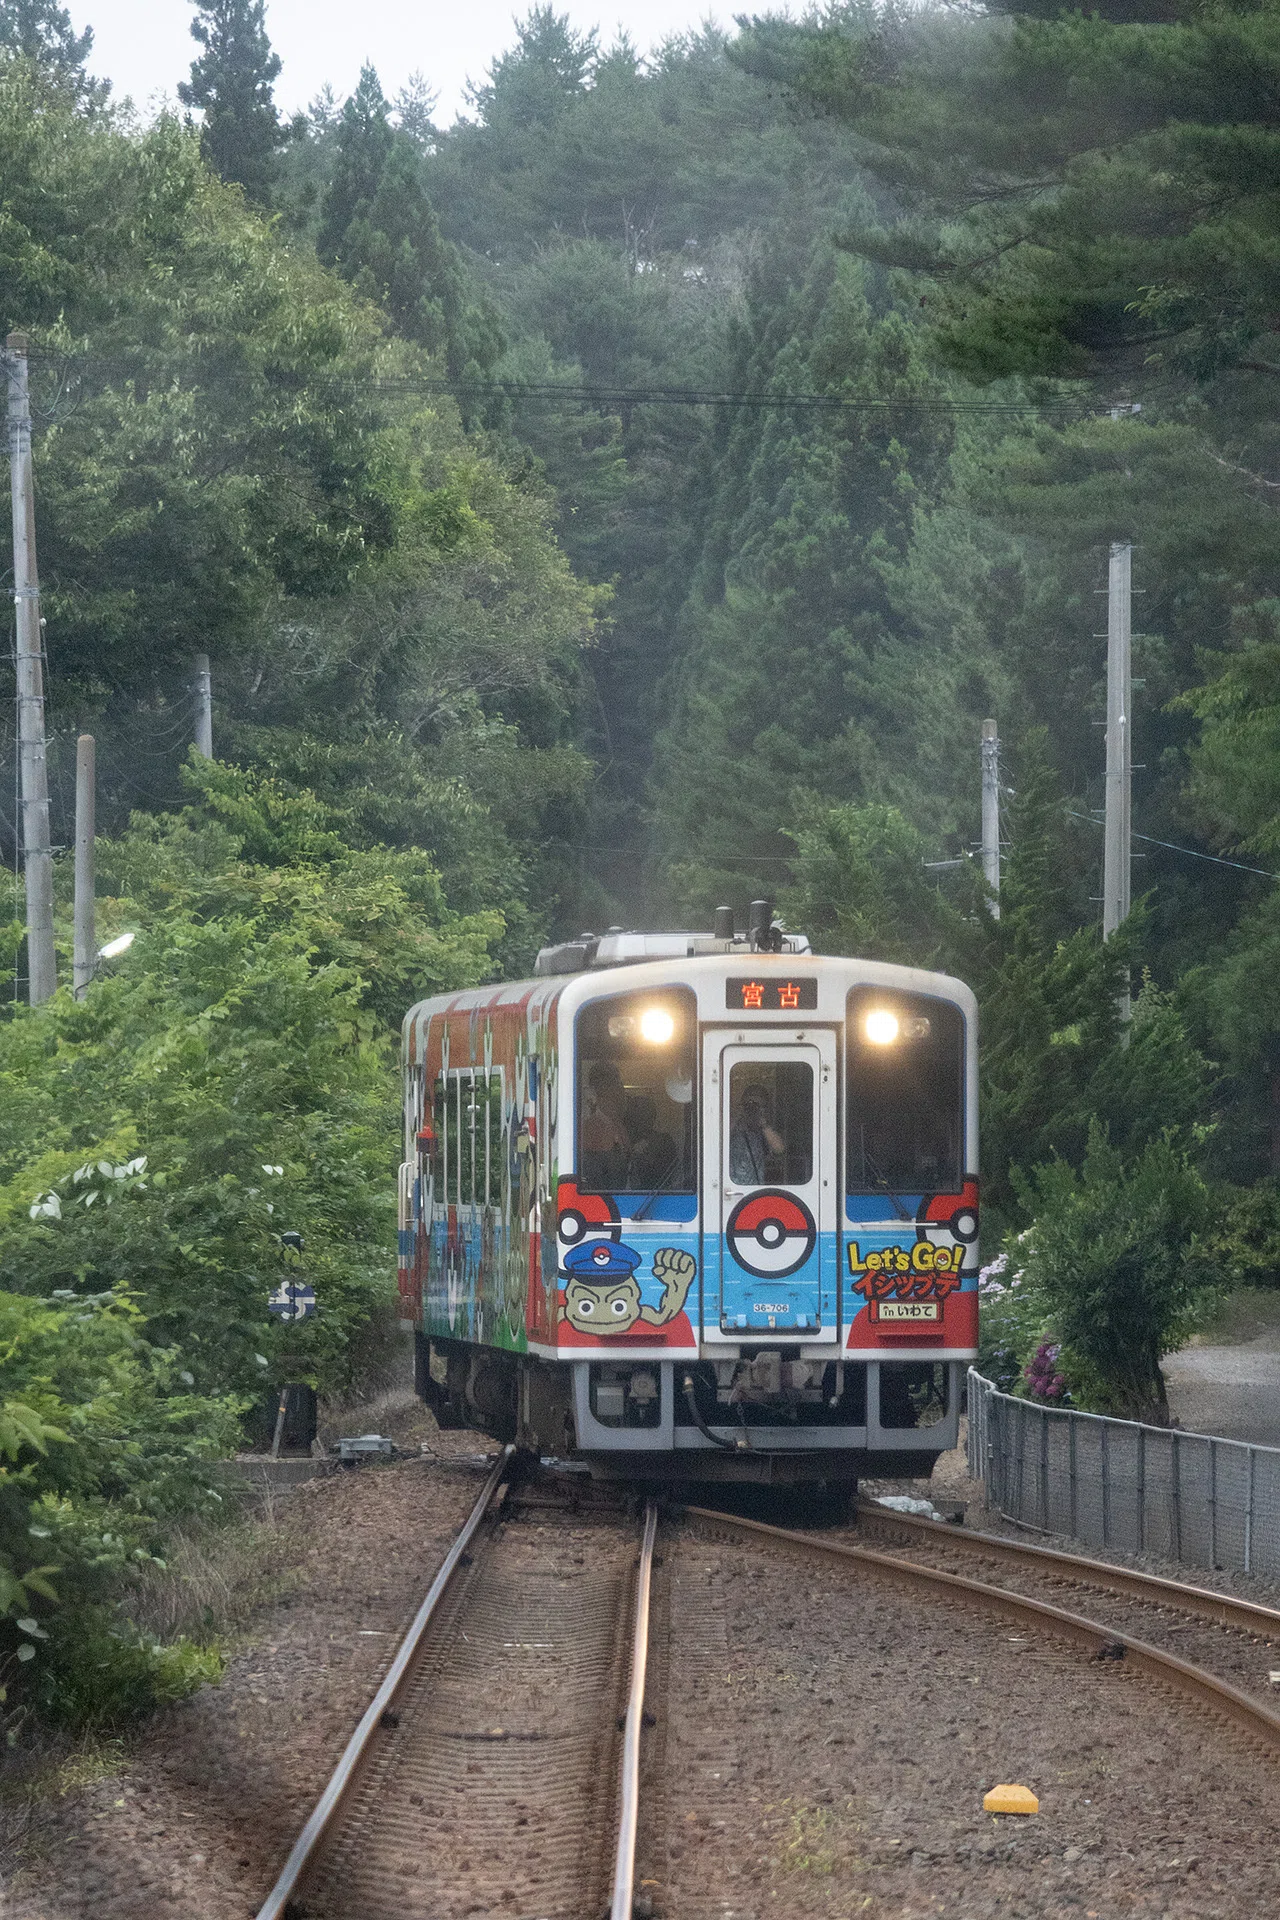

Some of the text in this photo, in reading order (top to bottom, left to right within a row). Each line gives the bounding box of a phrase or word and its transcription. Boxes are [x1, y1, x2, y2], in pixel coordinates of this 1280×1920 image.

[741, 982, 801, 1008] 宮古
[848, 1241, 965, 1273] Let's Go!
[853, 1269, 960, 1297] イシツブテ
[754, 1304, 788, 1312] 36-706
[883, 1304, 933, 1317] in いわて
